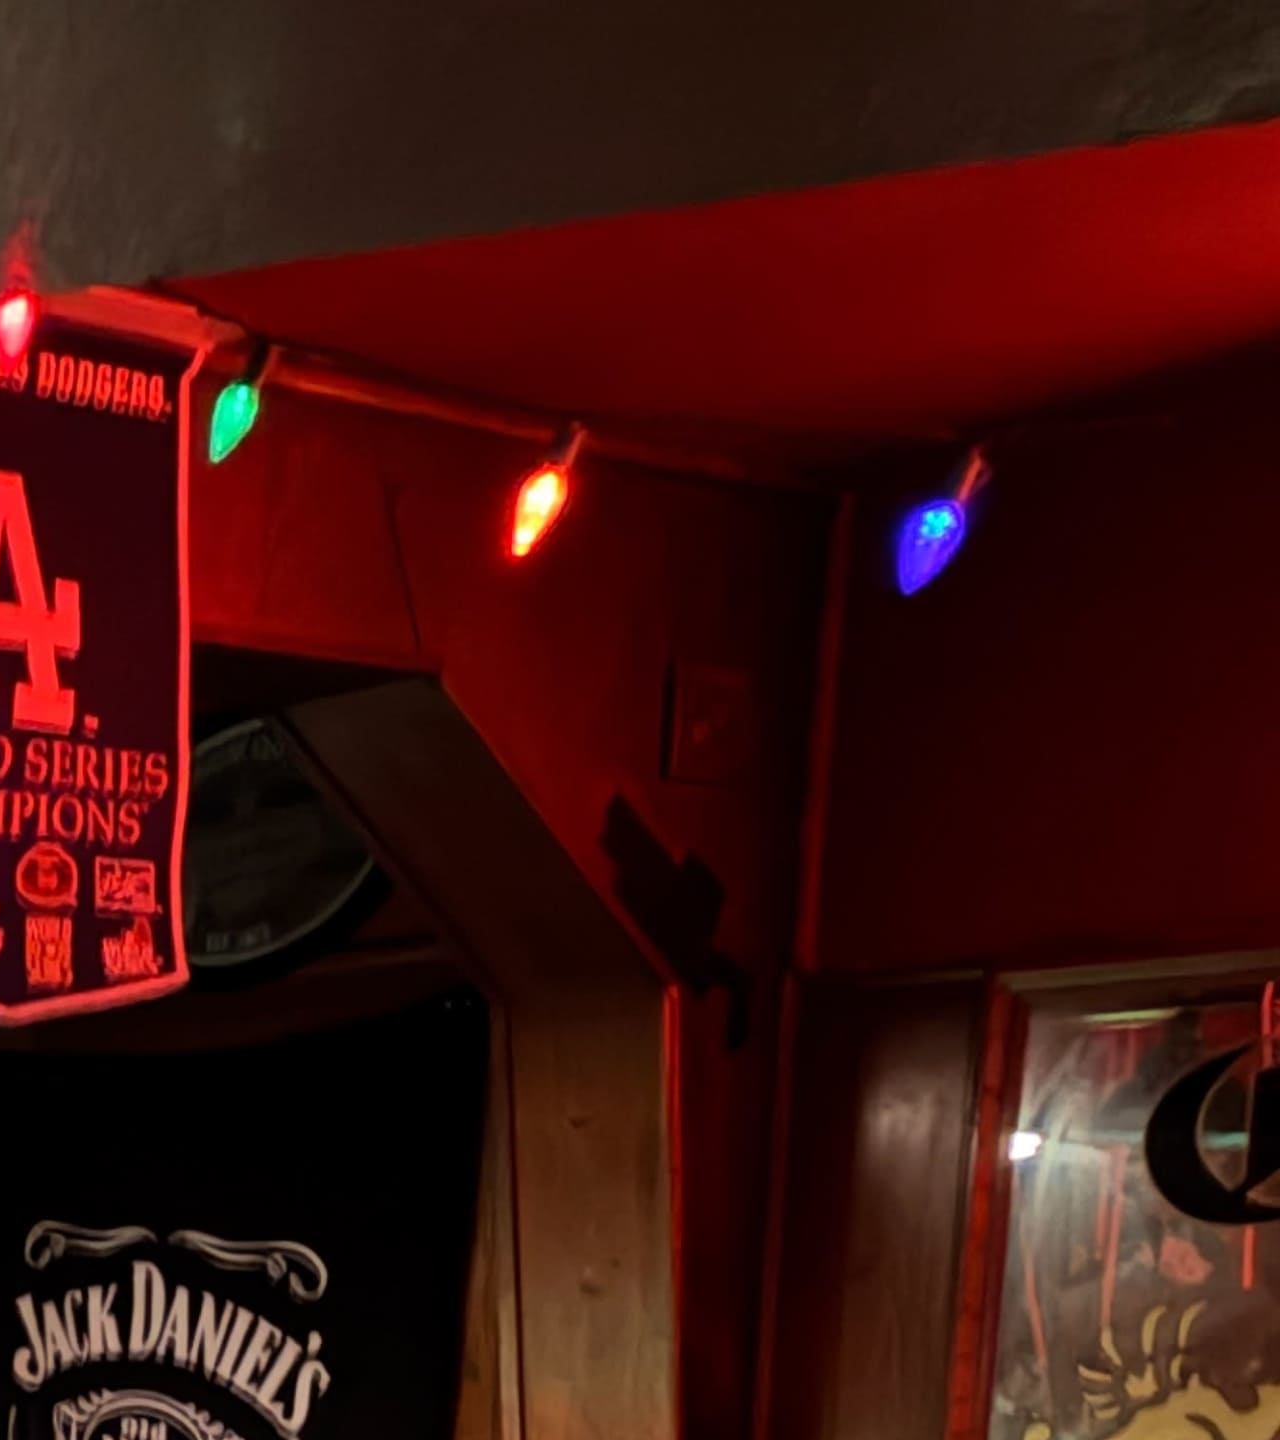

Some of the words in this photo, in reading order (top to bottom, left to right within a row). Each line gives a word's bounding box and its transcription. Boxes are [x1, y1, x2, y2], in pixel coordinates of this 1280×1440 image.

[36, 351, 168, 422] DODGERS
[24, 738, 170, 799] SERIES
[12, 1283, 124, 1392] JACK
[128, 1260, 332, 1439] DANIEL'S
